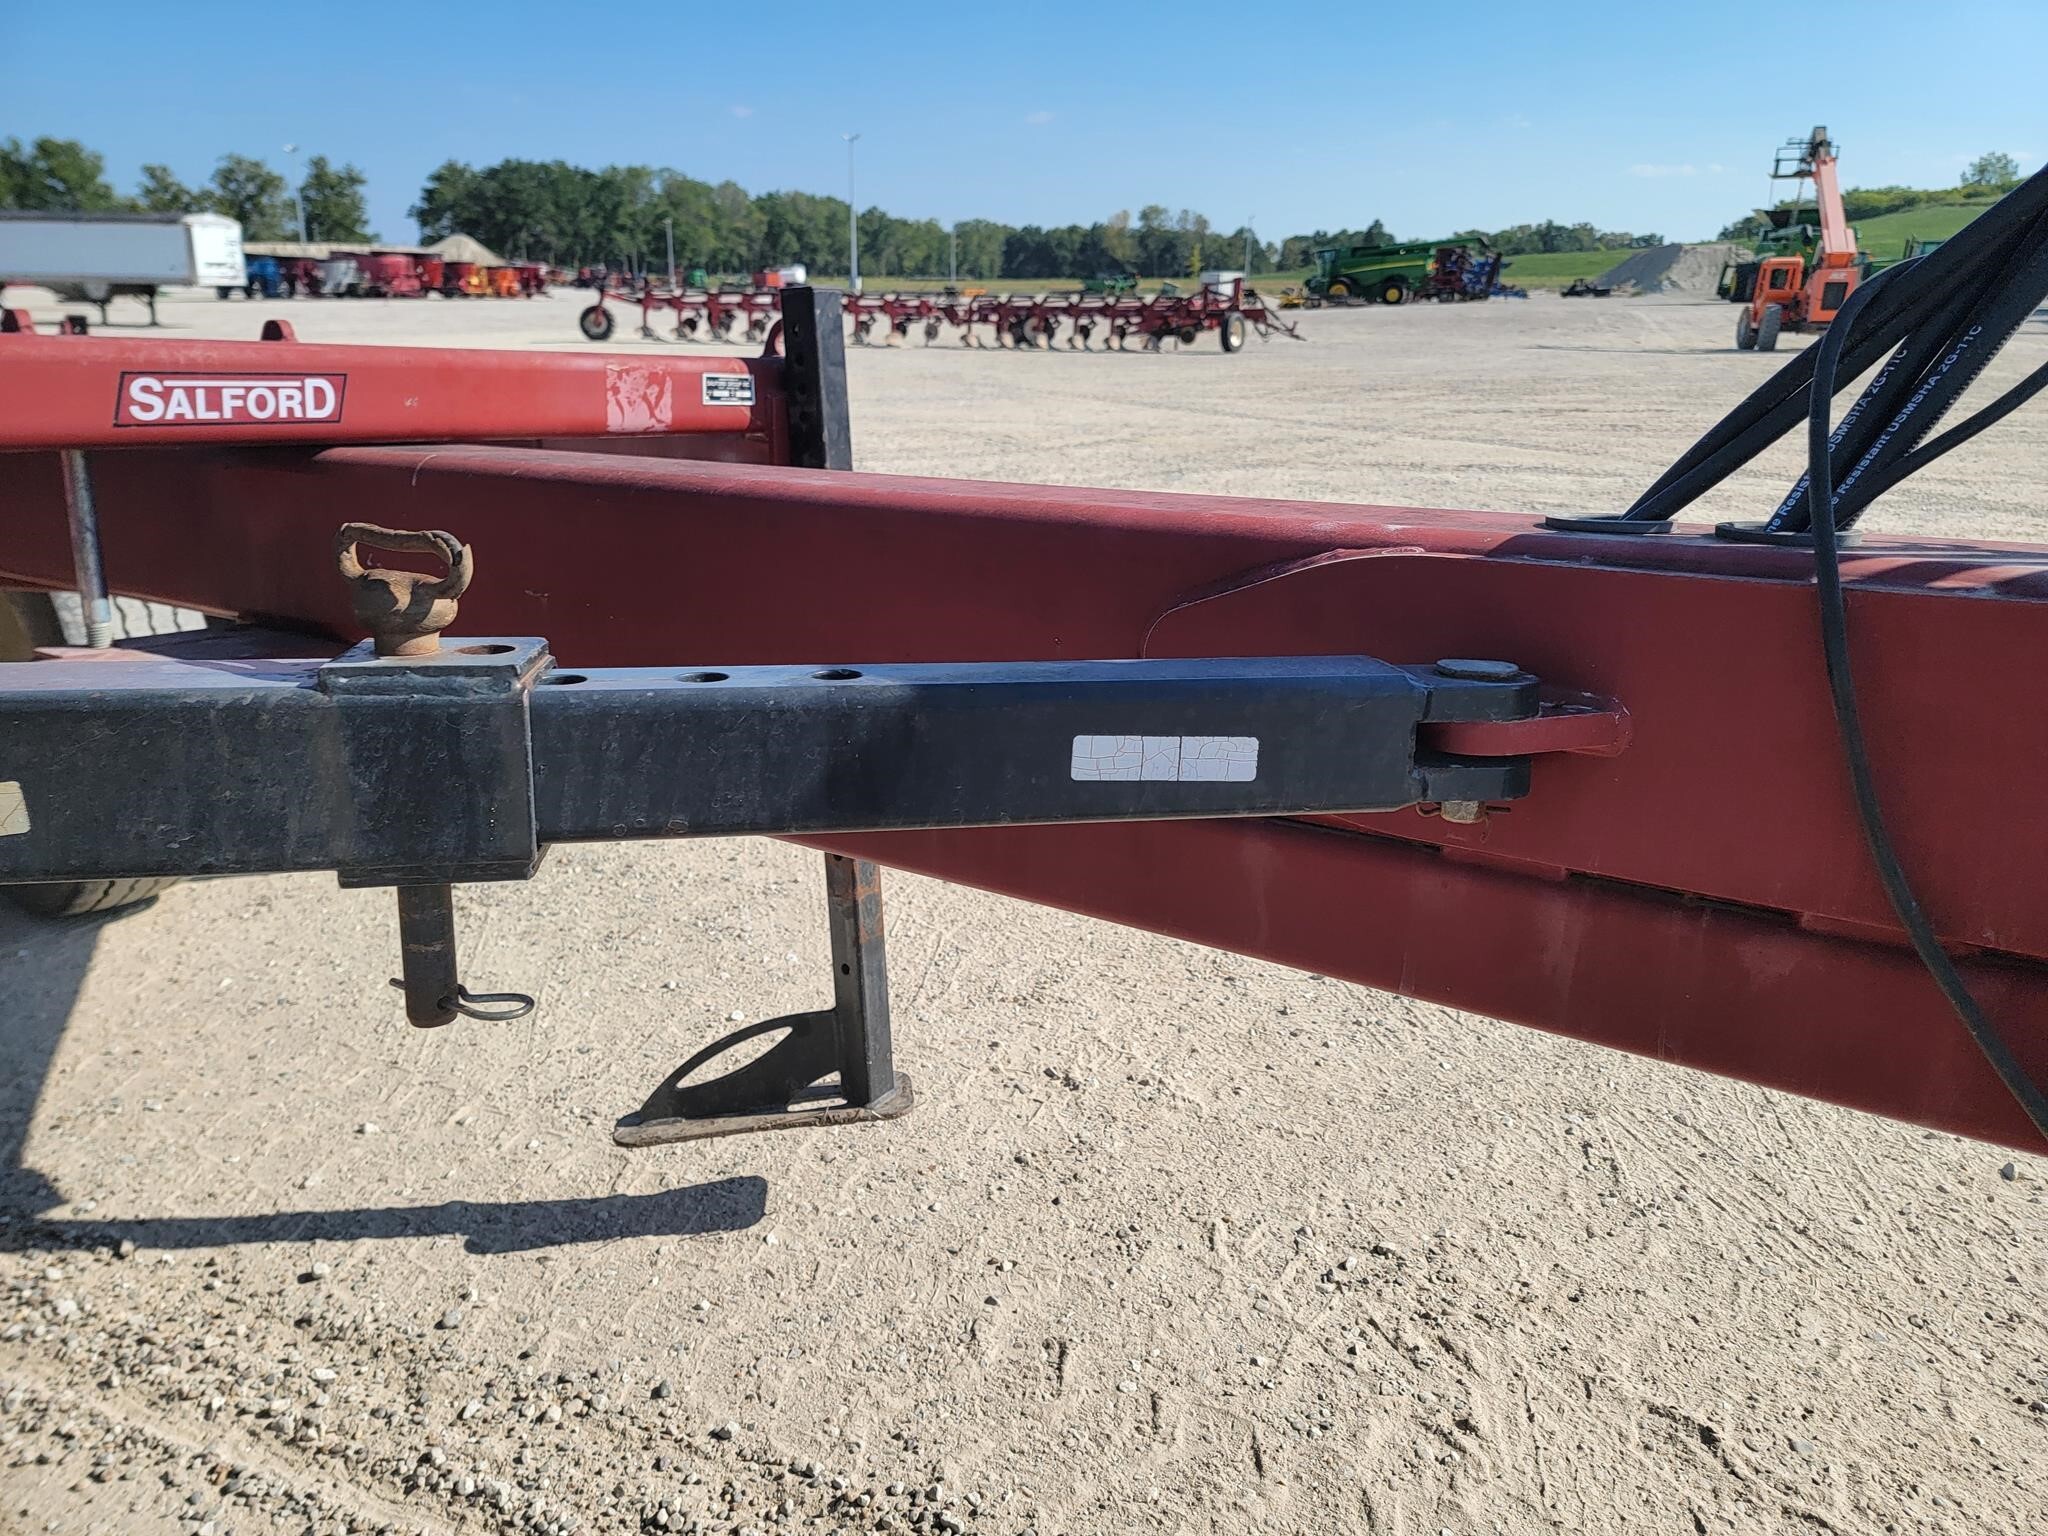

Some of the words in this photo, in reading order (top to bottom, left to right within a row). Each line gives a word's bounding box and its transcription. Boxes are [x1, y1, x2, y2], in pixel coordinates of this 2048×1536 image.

[129, 376, 335, 421] SALFORD
[1836, 433, 1891, 496] Resistant
[1938, 324, 1983, 373] 2G-11C
